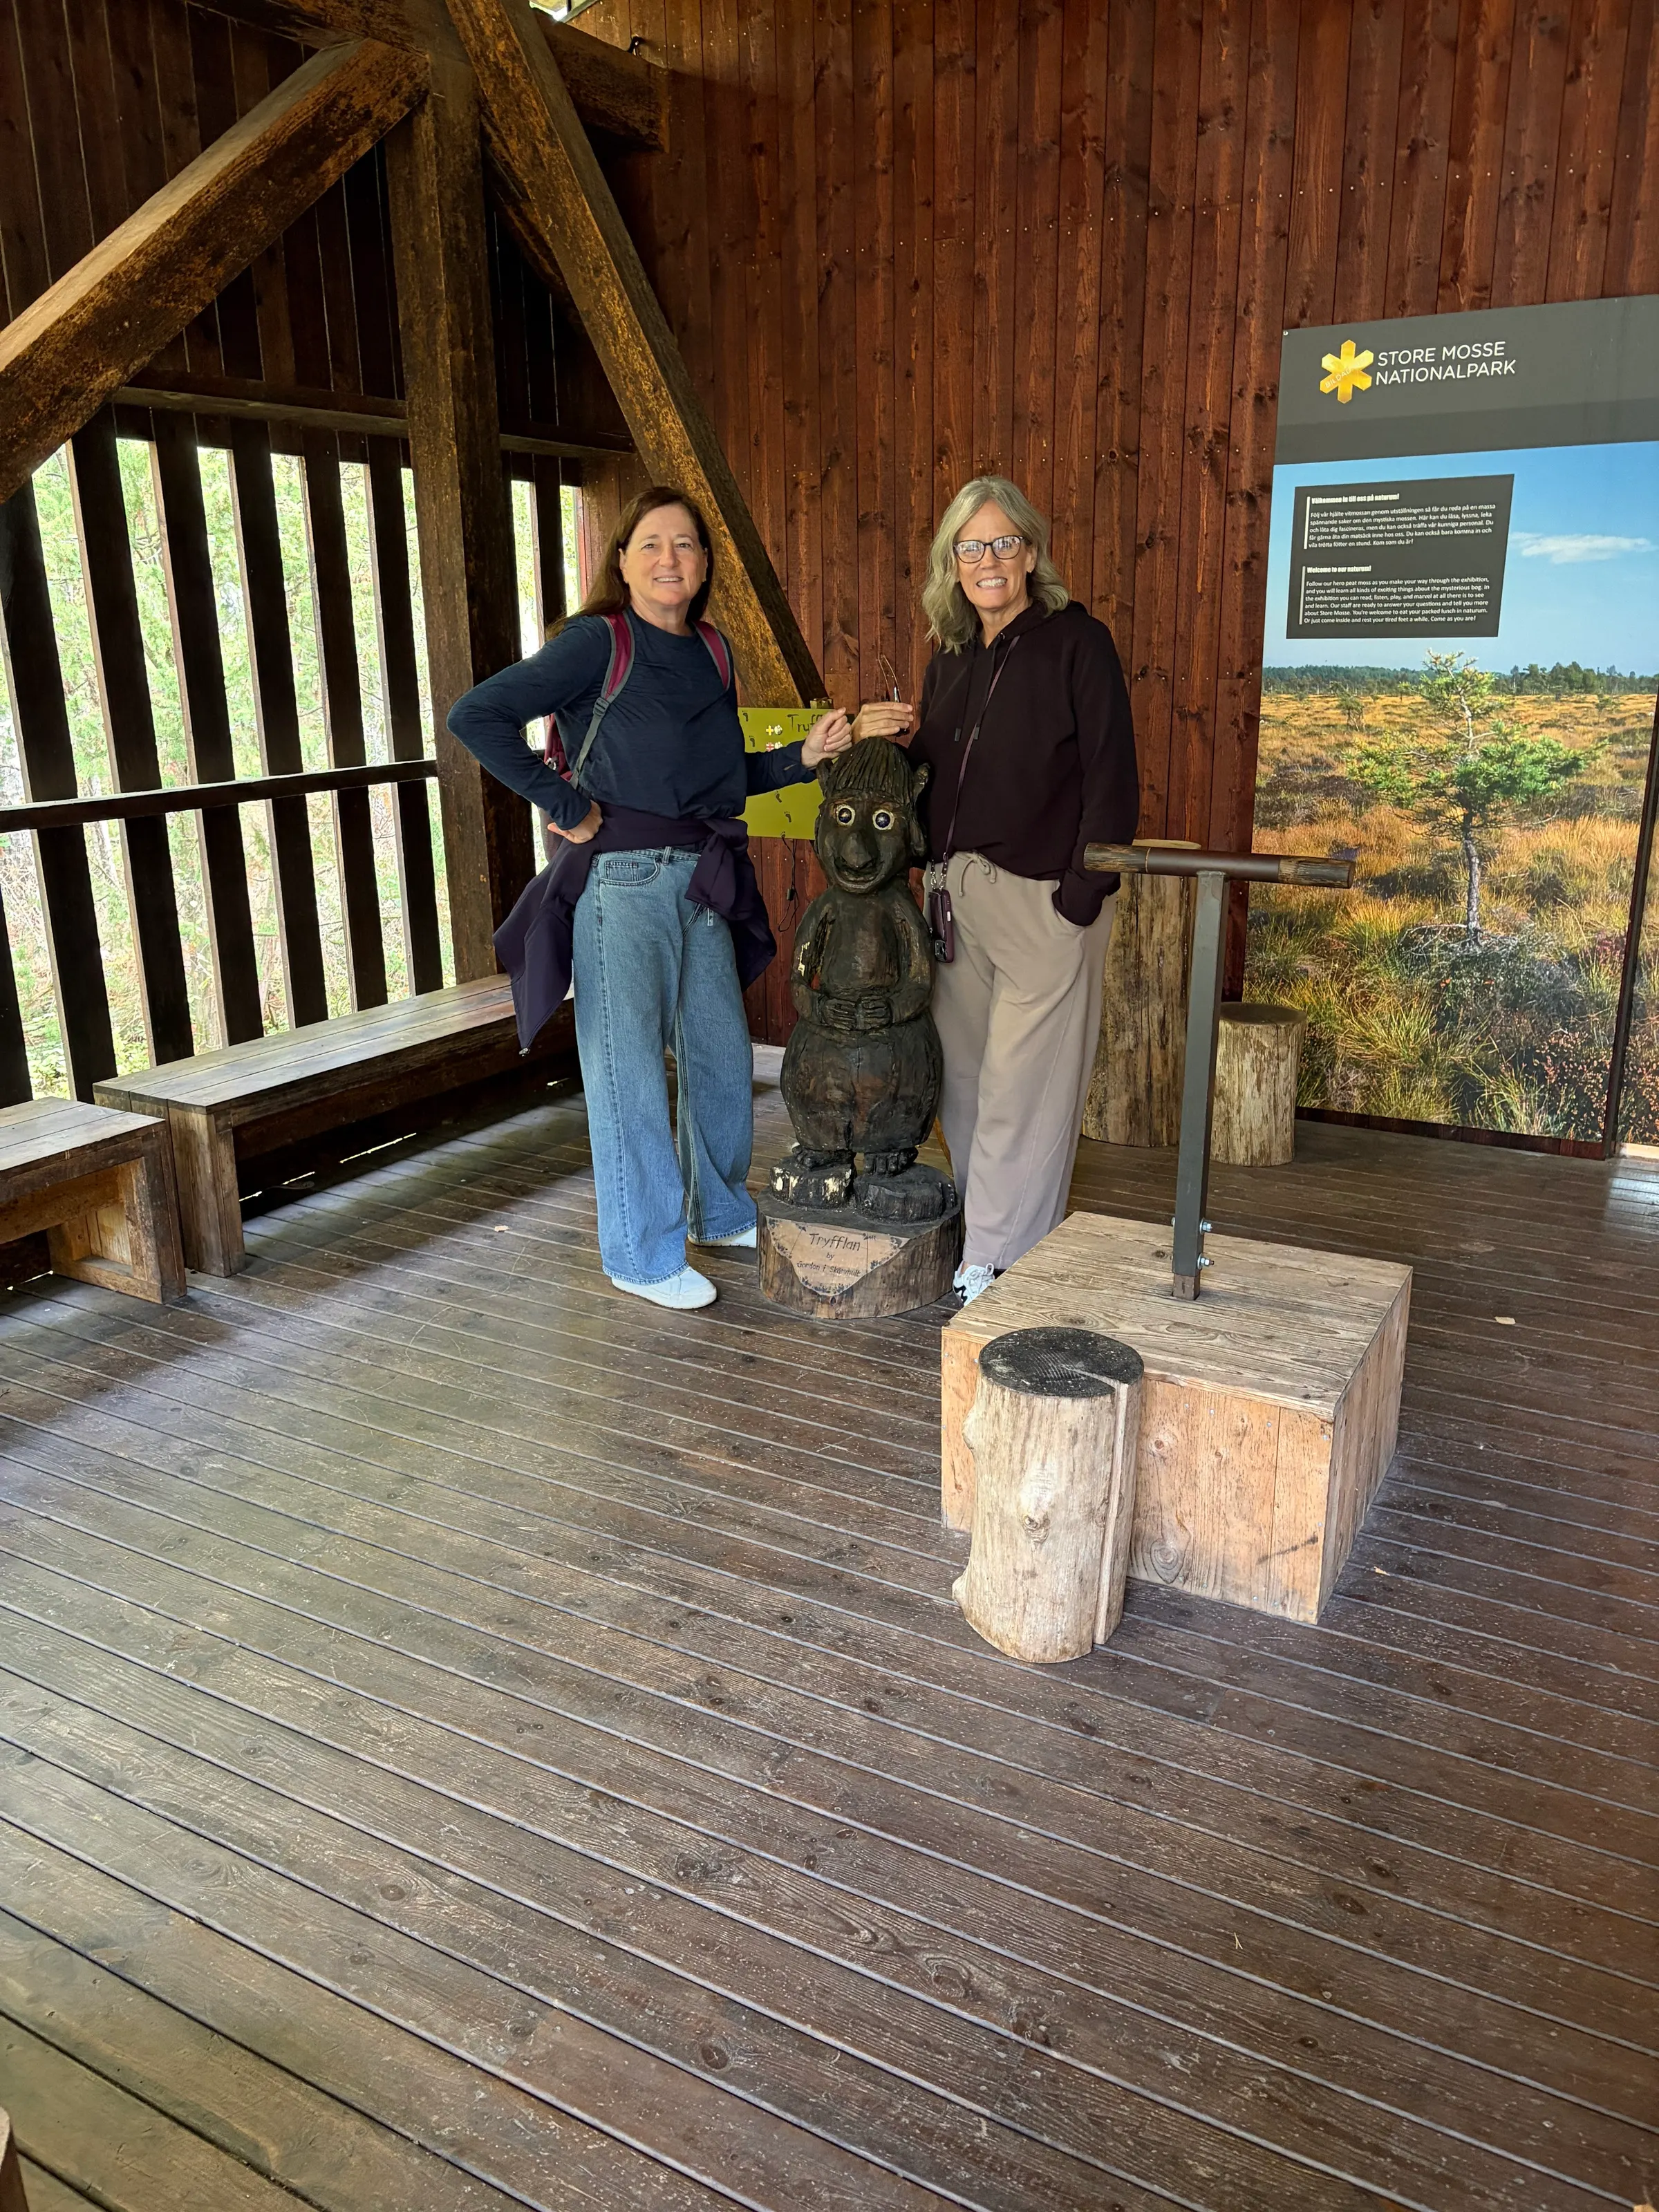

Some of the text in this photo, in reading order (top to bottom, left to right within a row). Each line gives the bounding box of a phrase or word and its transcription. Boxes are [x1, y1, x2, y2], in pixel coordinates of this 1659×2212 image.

[1378, 348, 1436, 366] STORE
[1442, 341, 1506, 361] MOSSE
[1376, 359, 1517, 386] NATIONALPARK
[1366, 494, 1374, 502] på
[1459, 519, 1485, 527] personal.
[809, 1233, 861, 1251] Tryfflan
[826, 1252, 835, 1261] by
